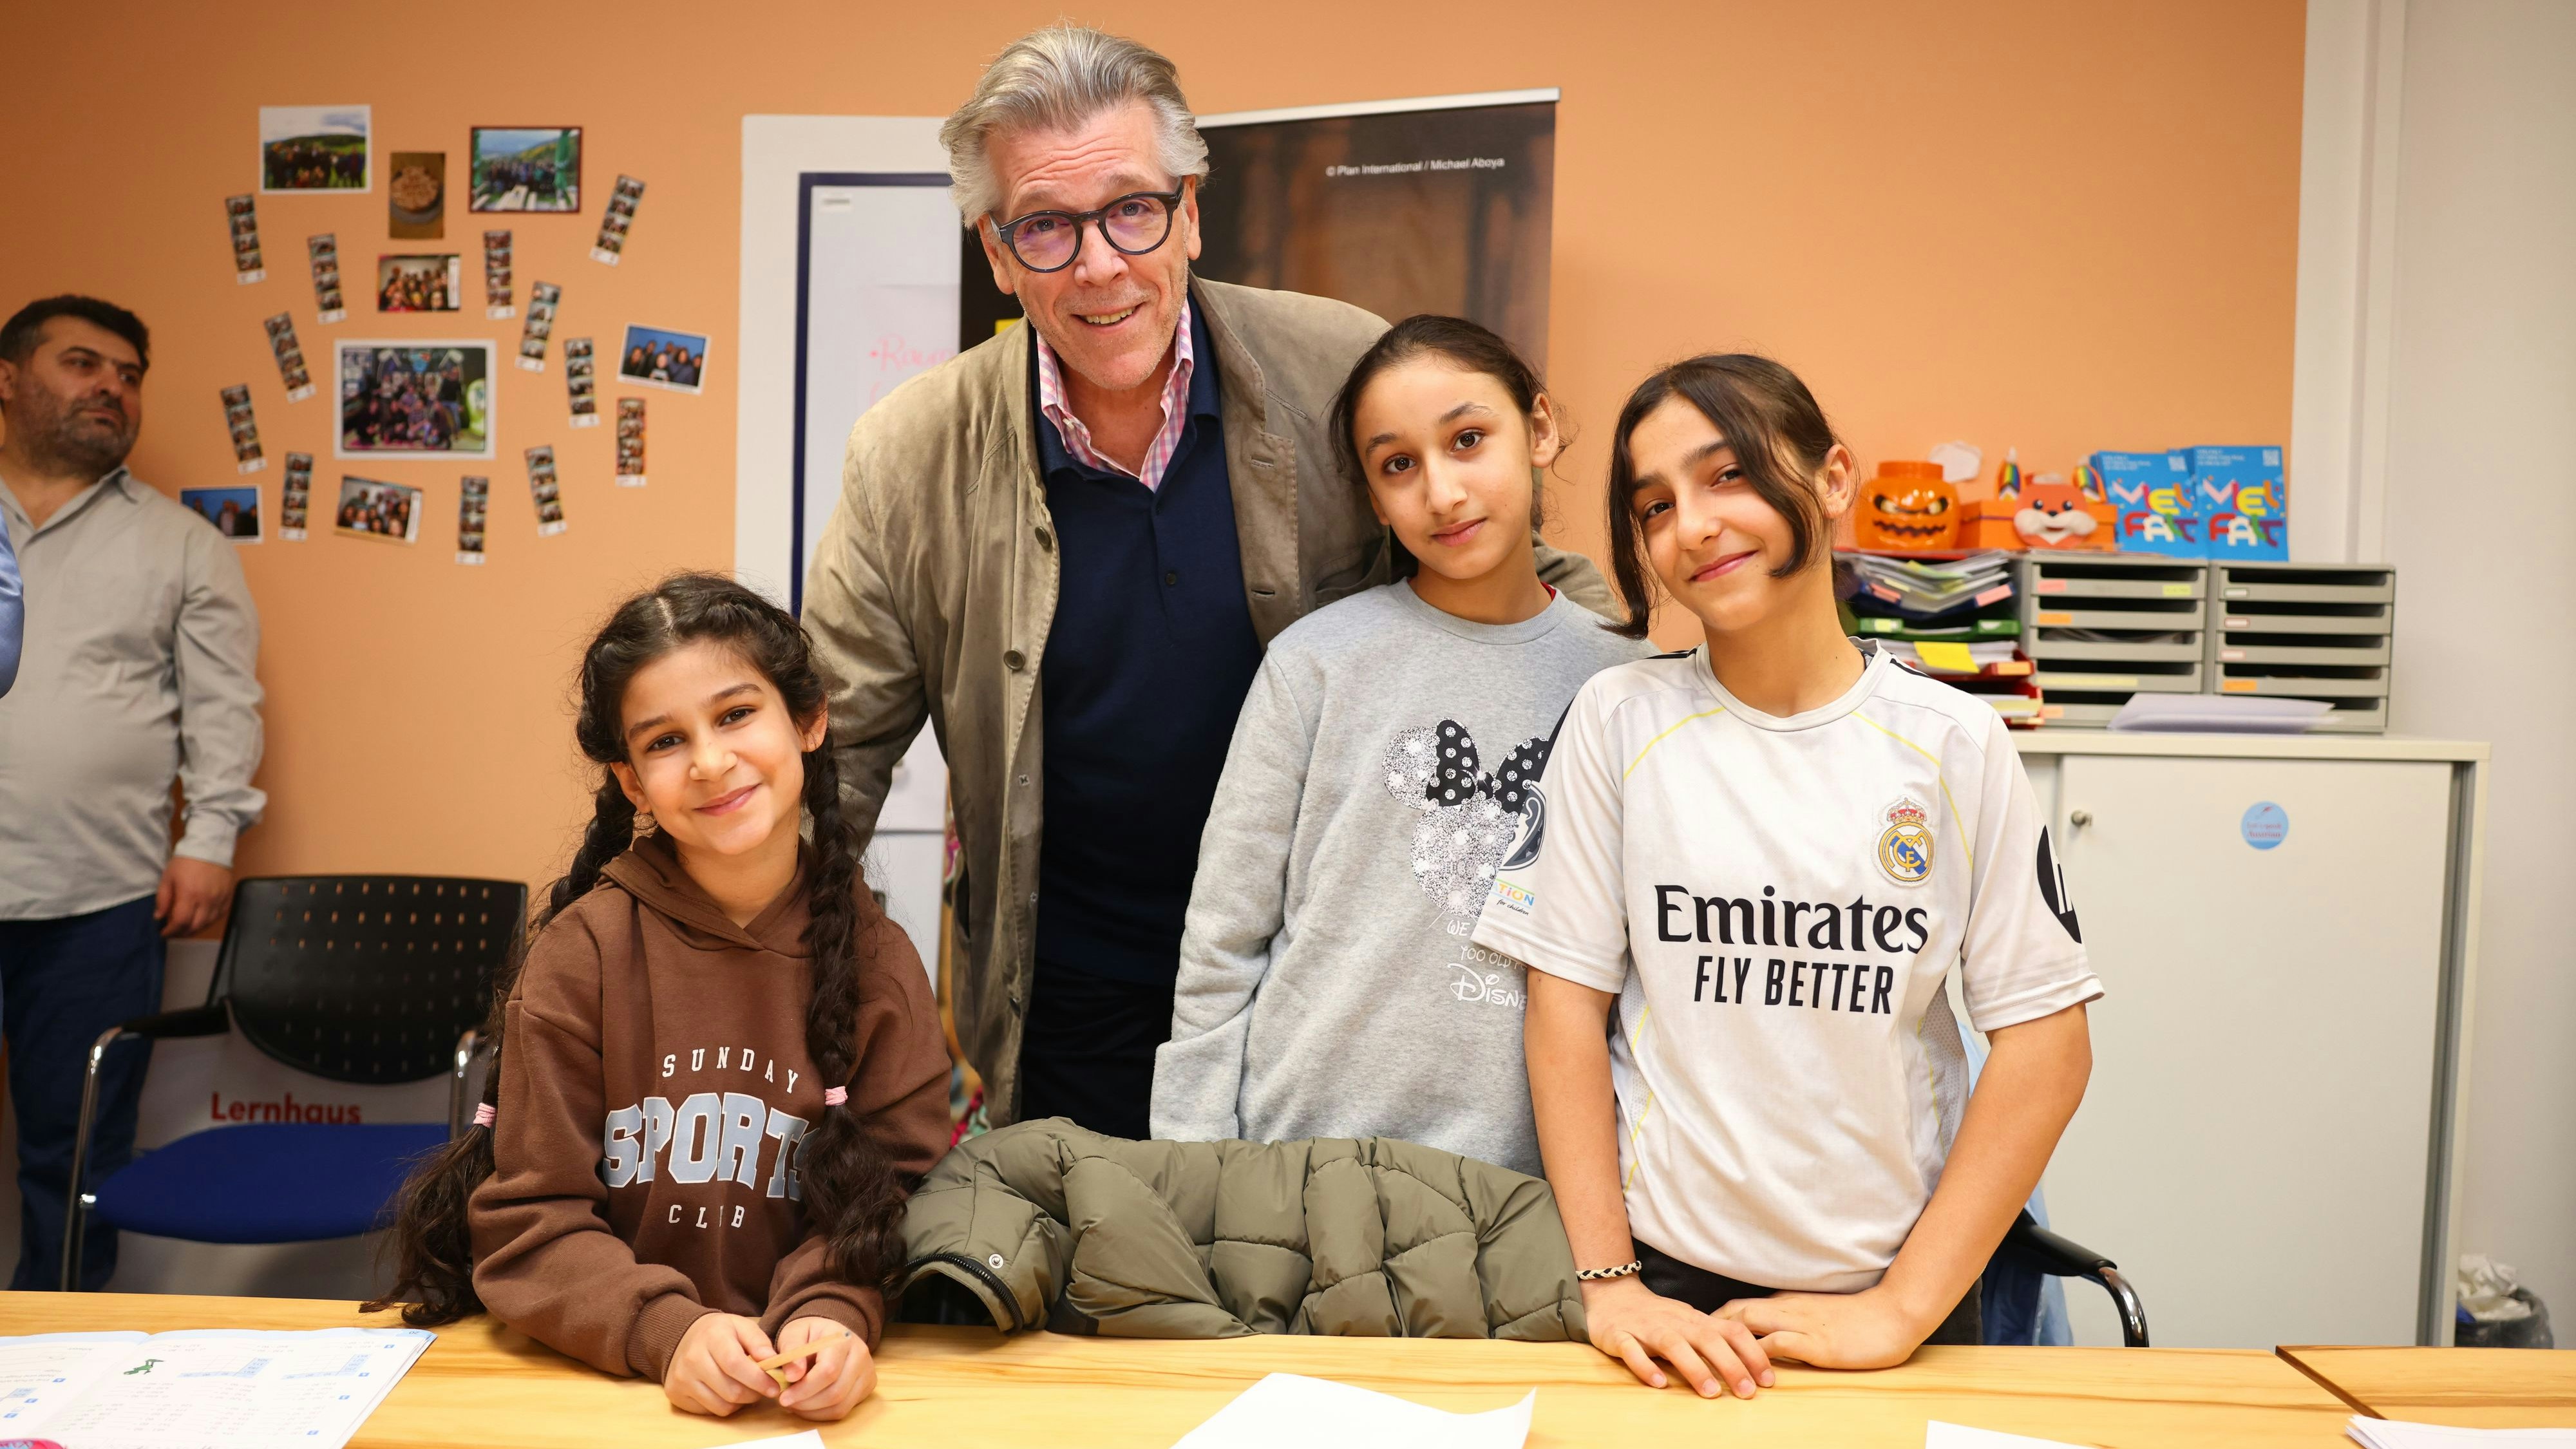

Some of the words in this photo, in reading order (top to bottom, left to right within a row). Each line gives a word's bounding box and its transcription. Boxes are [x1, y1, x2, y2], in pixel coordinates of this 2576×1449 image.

[1337, 165, 1361, 176] Plan
[1361, 162, 1423, 175] International
[1430, 159, 1471, 171] Michael
[1471, 157, 1506, 169] Aboya
[2123, 511, 2198, 544] FALT
[2208, 512, 2283, 547] FALT
[1507, 904, 1529, 916] children
[1654, 884, 1928, 954] Emirates
[1446, 919, 1470, 936] WE
[1694, 956, 1750, 1005] FLY
[1765, 958, 1893, 1014] BETTER
[661, 1046, 799, 1094] SUNDAY
[211, 1092, 362, 1124] Lernhaus
[668, 1204, 745, 1229] CLB
